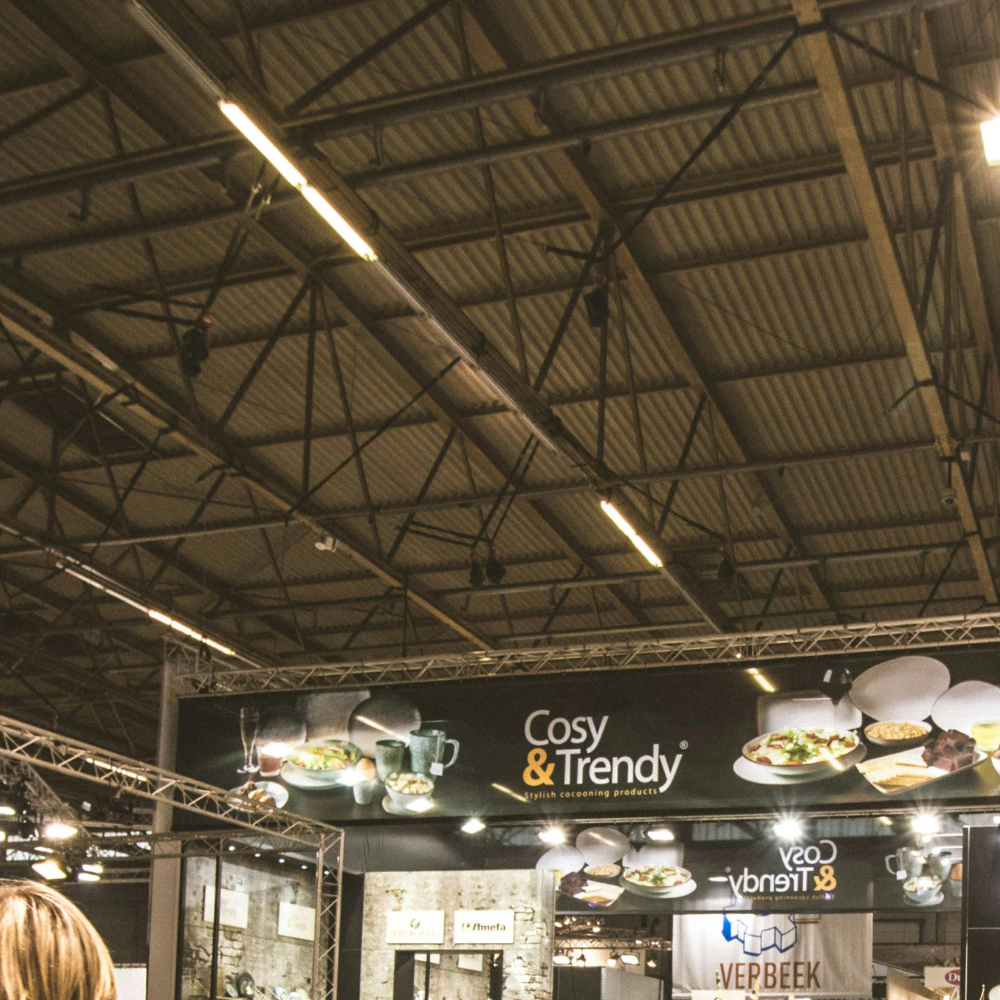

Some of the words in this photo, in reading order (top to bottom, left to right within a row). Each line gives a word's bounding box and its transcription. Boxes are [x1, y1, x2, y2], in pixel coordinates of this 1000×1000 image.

[524, 709, 609, 754] Cosy
[522, 747, 556, 787] &
[524, 791, 556, 800] Stylish
[560, 789, 610, 798] cocooning
[613, 787, 658, 797] products
[719, 961, 821, 990] VERBEEK
